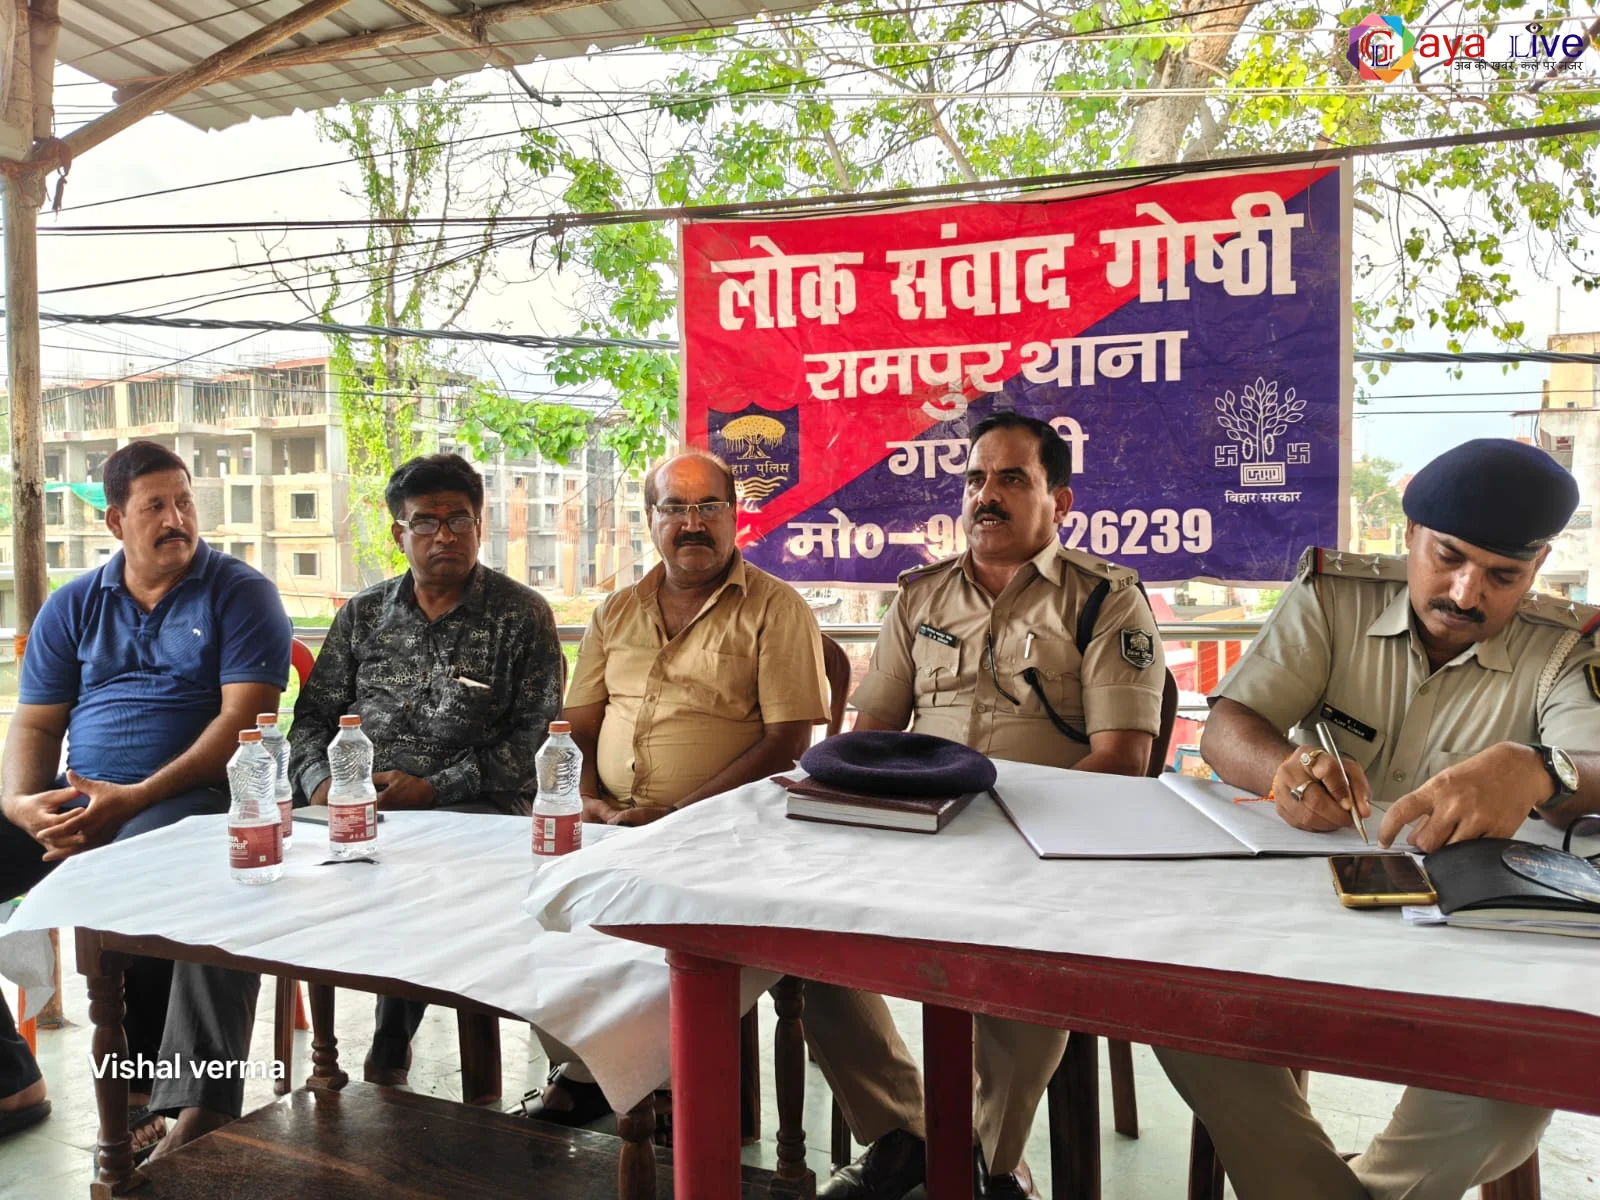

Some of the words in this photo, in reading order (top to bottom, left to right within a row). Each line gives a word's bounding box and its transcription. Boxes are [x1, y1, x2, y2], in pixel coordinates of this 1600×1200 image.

[711, 235, 864, 331] लोक
[888, 222, 1075, 321] संवाद
[1100, 190, 1305, 305] गोष्ठी
[804, 341, 1012, 421] रामपुर
[1020, 330, 1189, 387] थाना
[755, 460, 789, 477] पुलिस
[1224, 490, 1258, 504] बिहार
[1260, 492, 1302, 503] सरकार
